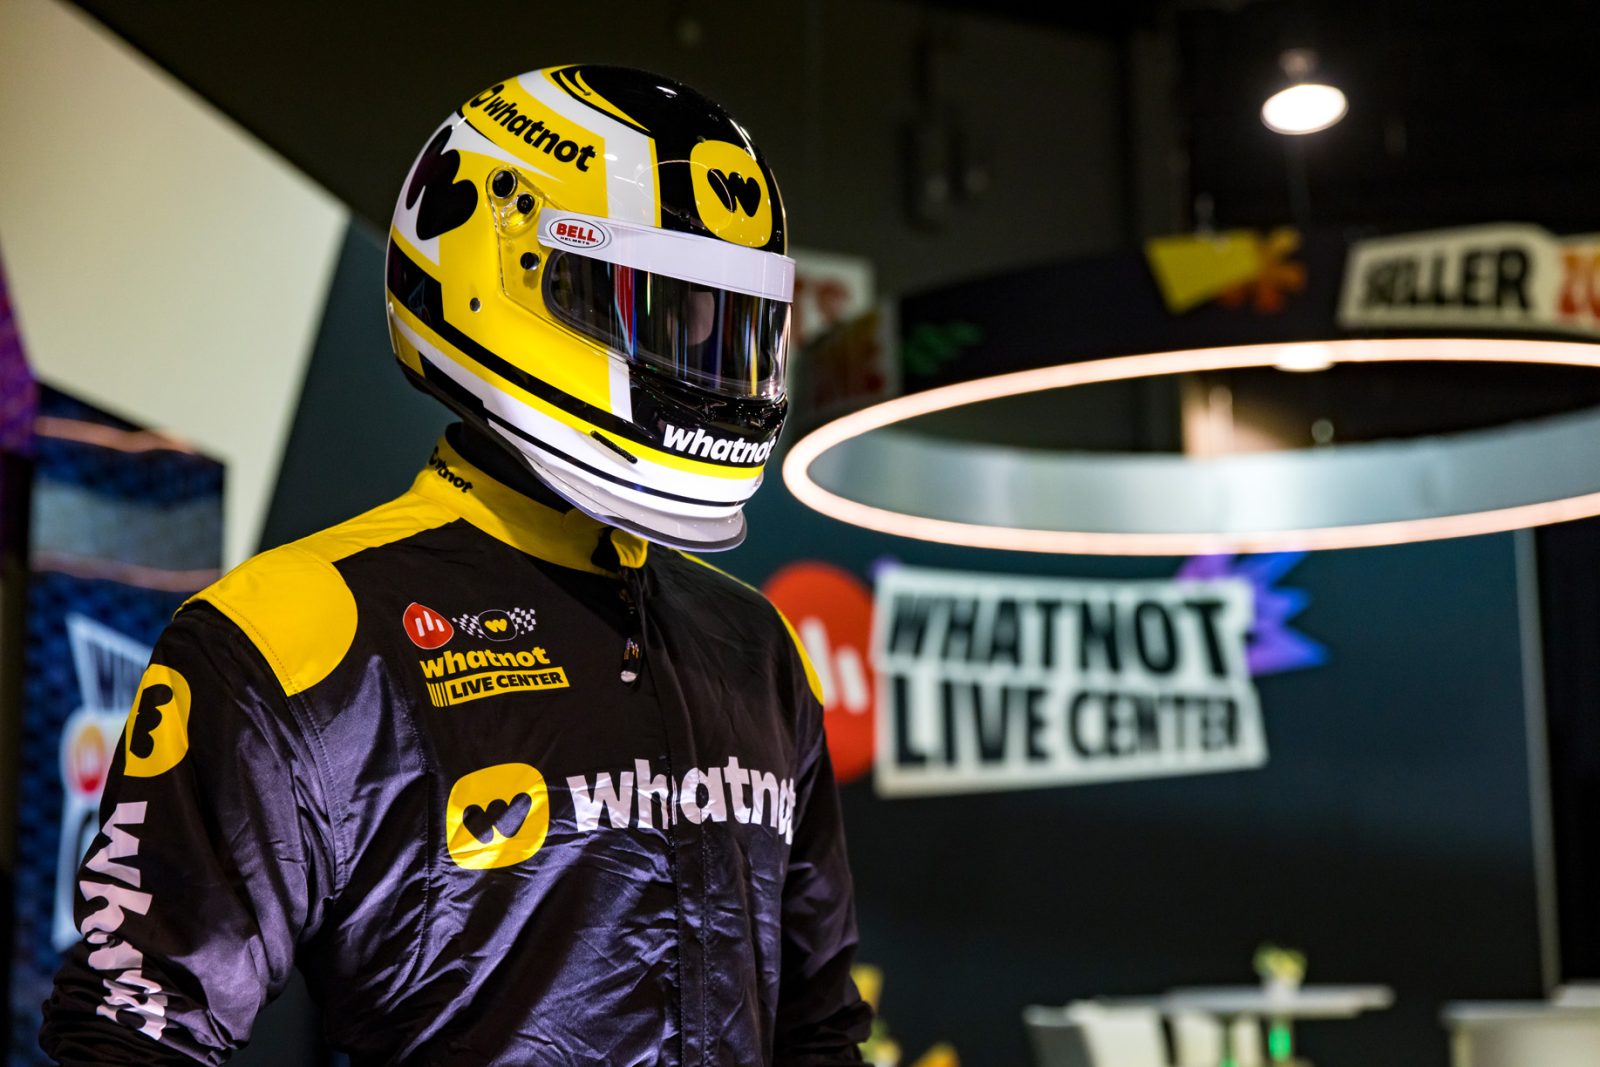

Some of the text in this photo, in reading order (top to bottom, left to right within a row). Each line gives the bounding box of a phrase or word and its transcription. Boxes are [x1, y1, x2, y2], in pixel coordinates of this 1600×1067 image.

[482, 96, 596, 172] whatnot
[556, 222, 597, 242] BELL
[887, 592, 1232, 678] WHATNOT
[419, 646, 551, 679] whatnot
[451, 672, 564, 700] LIVE CENTER
[893, 674, 1243, 768] LIVE CENTER
